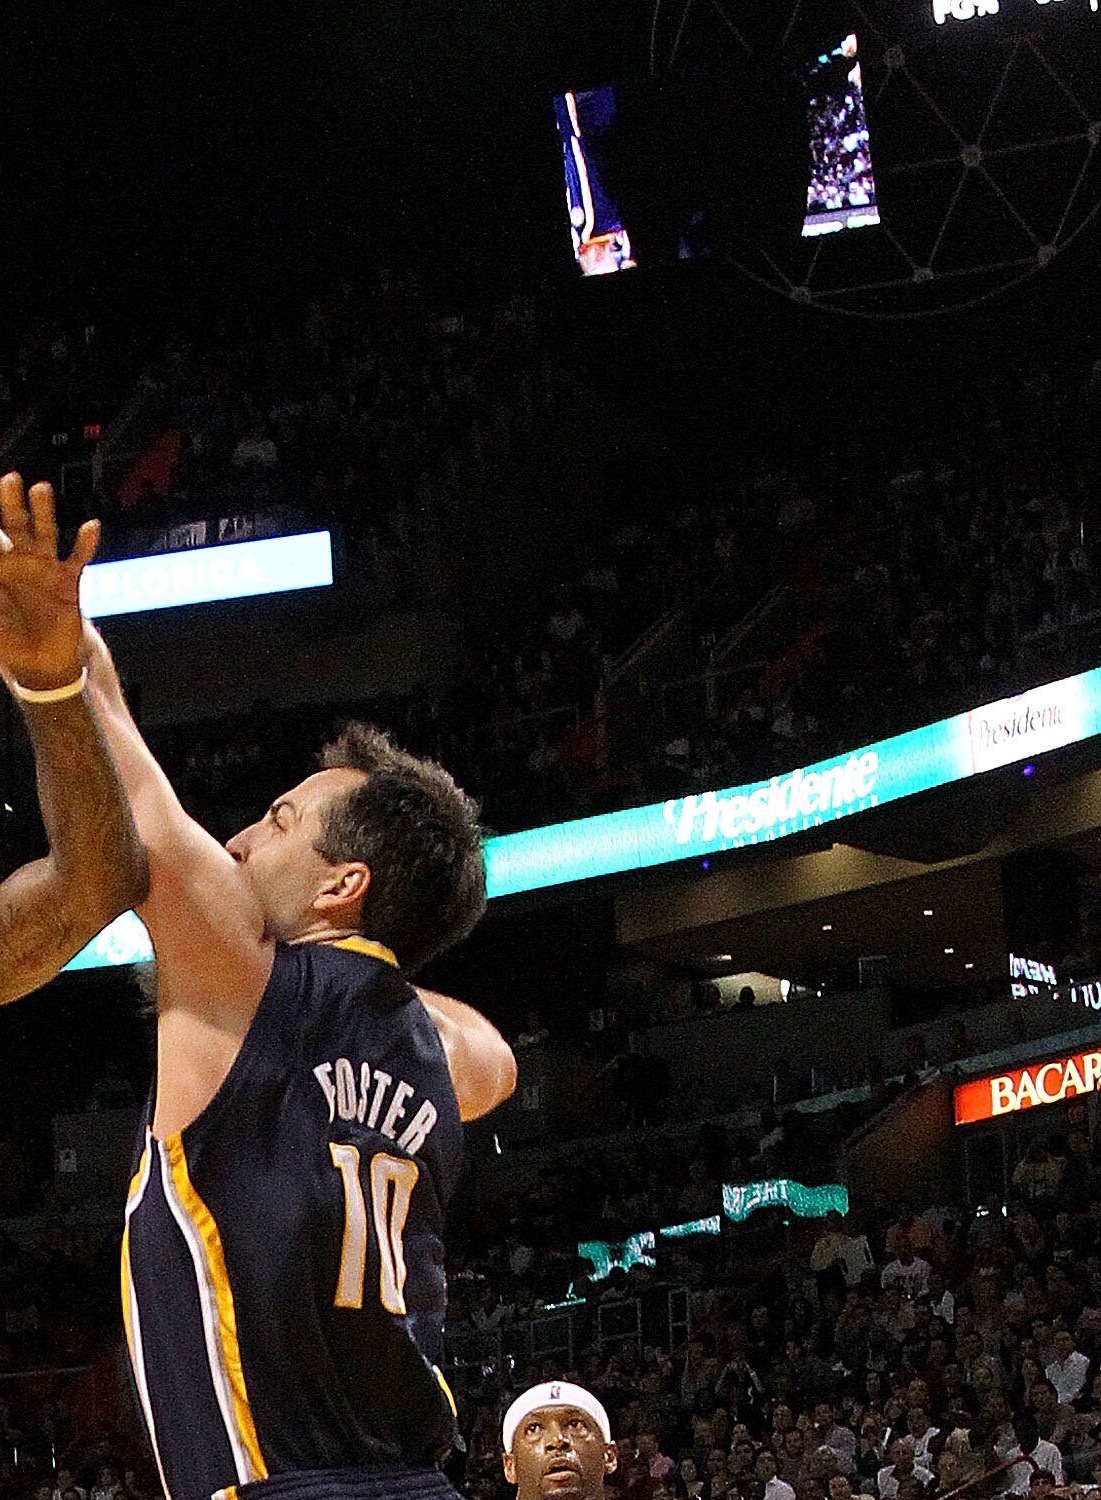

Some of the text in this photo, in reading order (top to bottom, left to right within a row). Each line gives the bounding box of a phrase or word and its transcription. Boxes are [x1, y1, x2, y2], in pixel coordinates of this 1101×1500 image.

[664, 751, 879, 845] Presidente
[313, 1057, 438, 1156] FOSTER
[329, 1142, 420, 1316] 10
